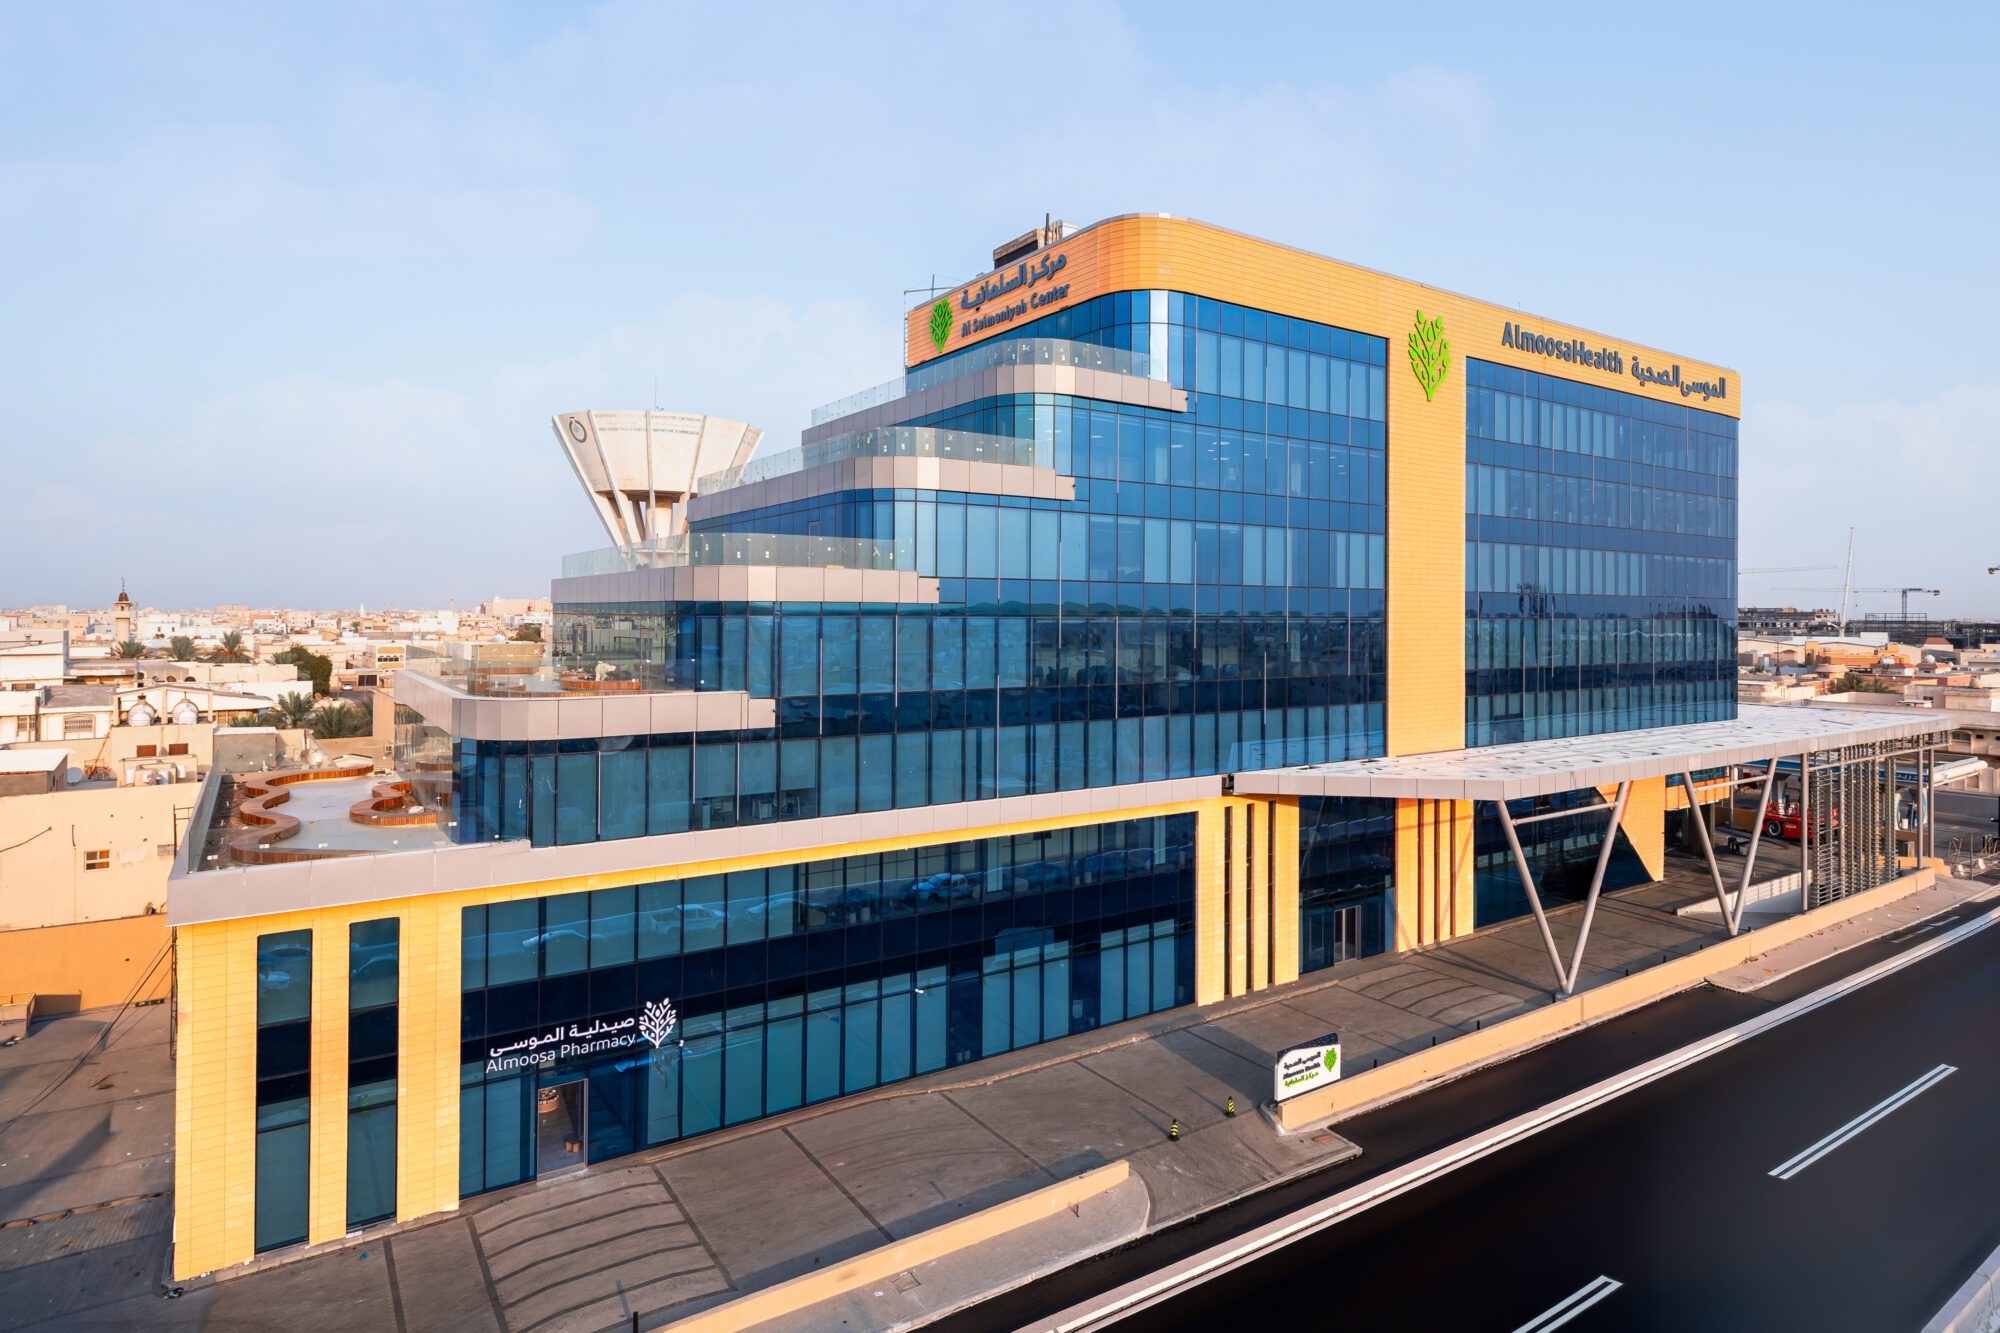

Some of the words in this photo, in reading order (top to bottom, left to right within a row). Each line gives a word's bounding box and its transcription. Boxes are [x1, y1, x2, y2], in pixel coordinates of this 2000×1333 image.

[960, 263, 1027, 311] السلمانية
[1028, 252, 1067, 288] مركز
[961, 319, 971, 337] Al
[1030, 283, 1070, 309] Center
[1631, 355, 1680, 387] الصحية
[1681, 377, 1726, 401] الموسى
[490, 1026, 564, 1057] الموسى
[569, 1017, 635, 1039] صيدلية
[485, 1050, 556, 1073] Almoosa
[560, 1033, 636, 1059] Pharmacy
